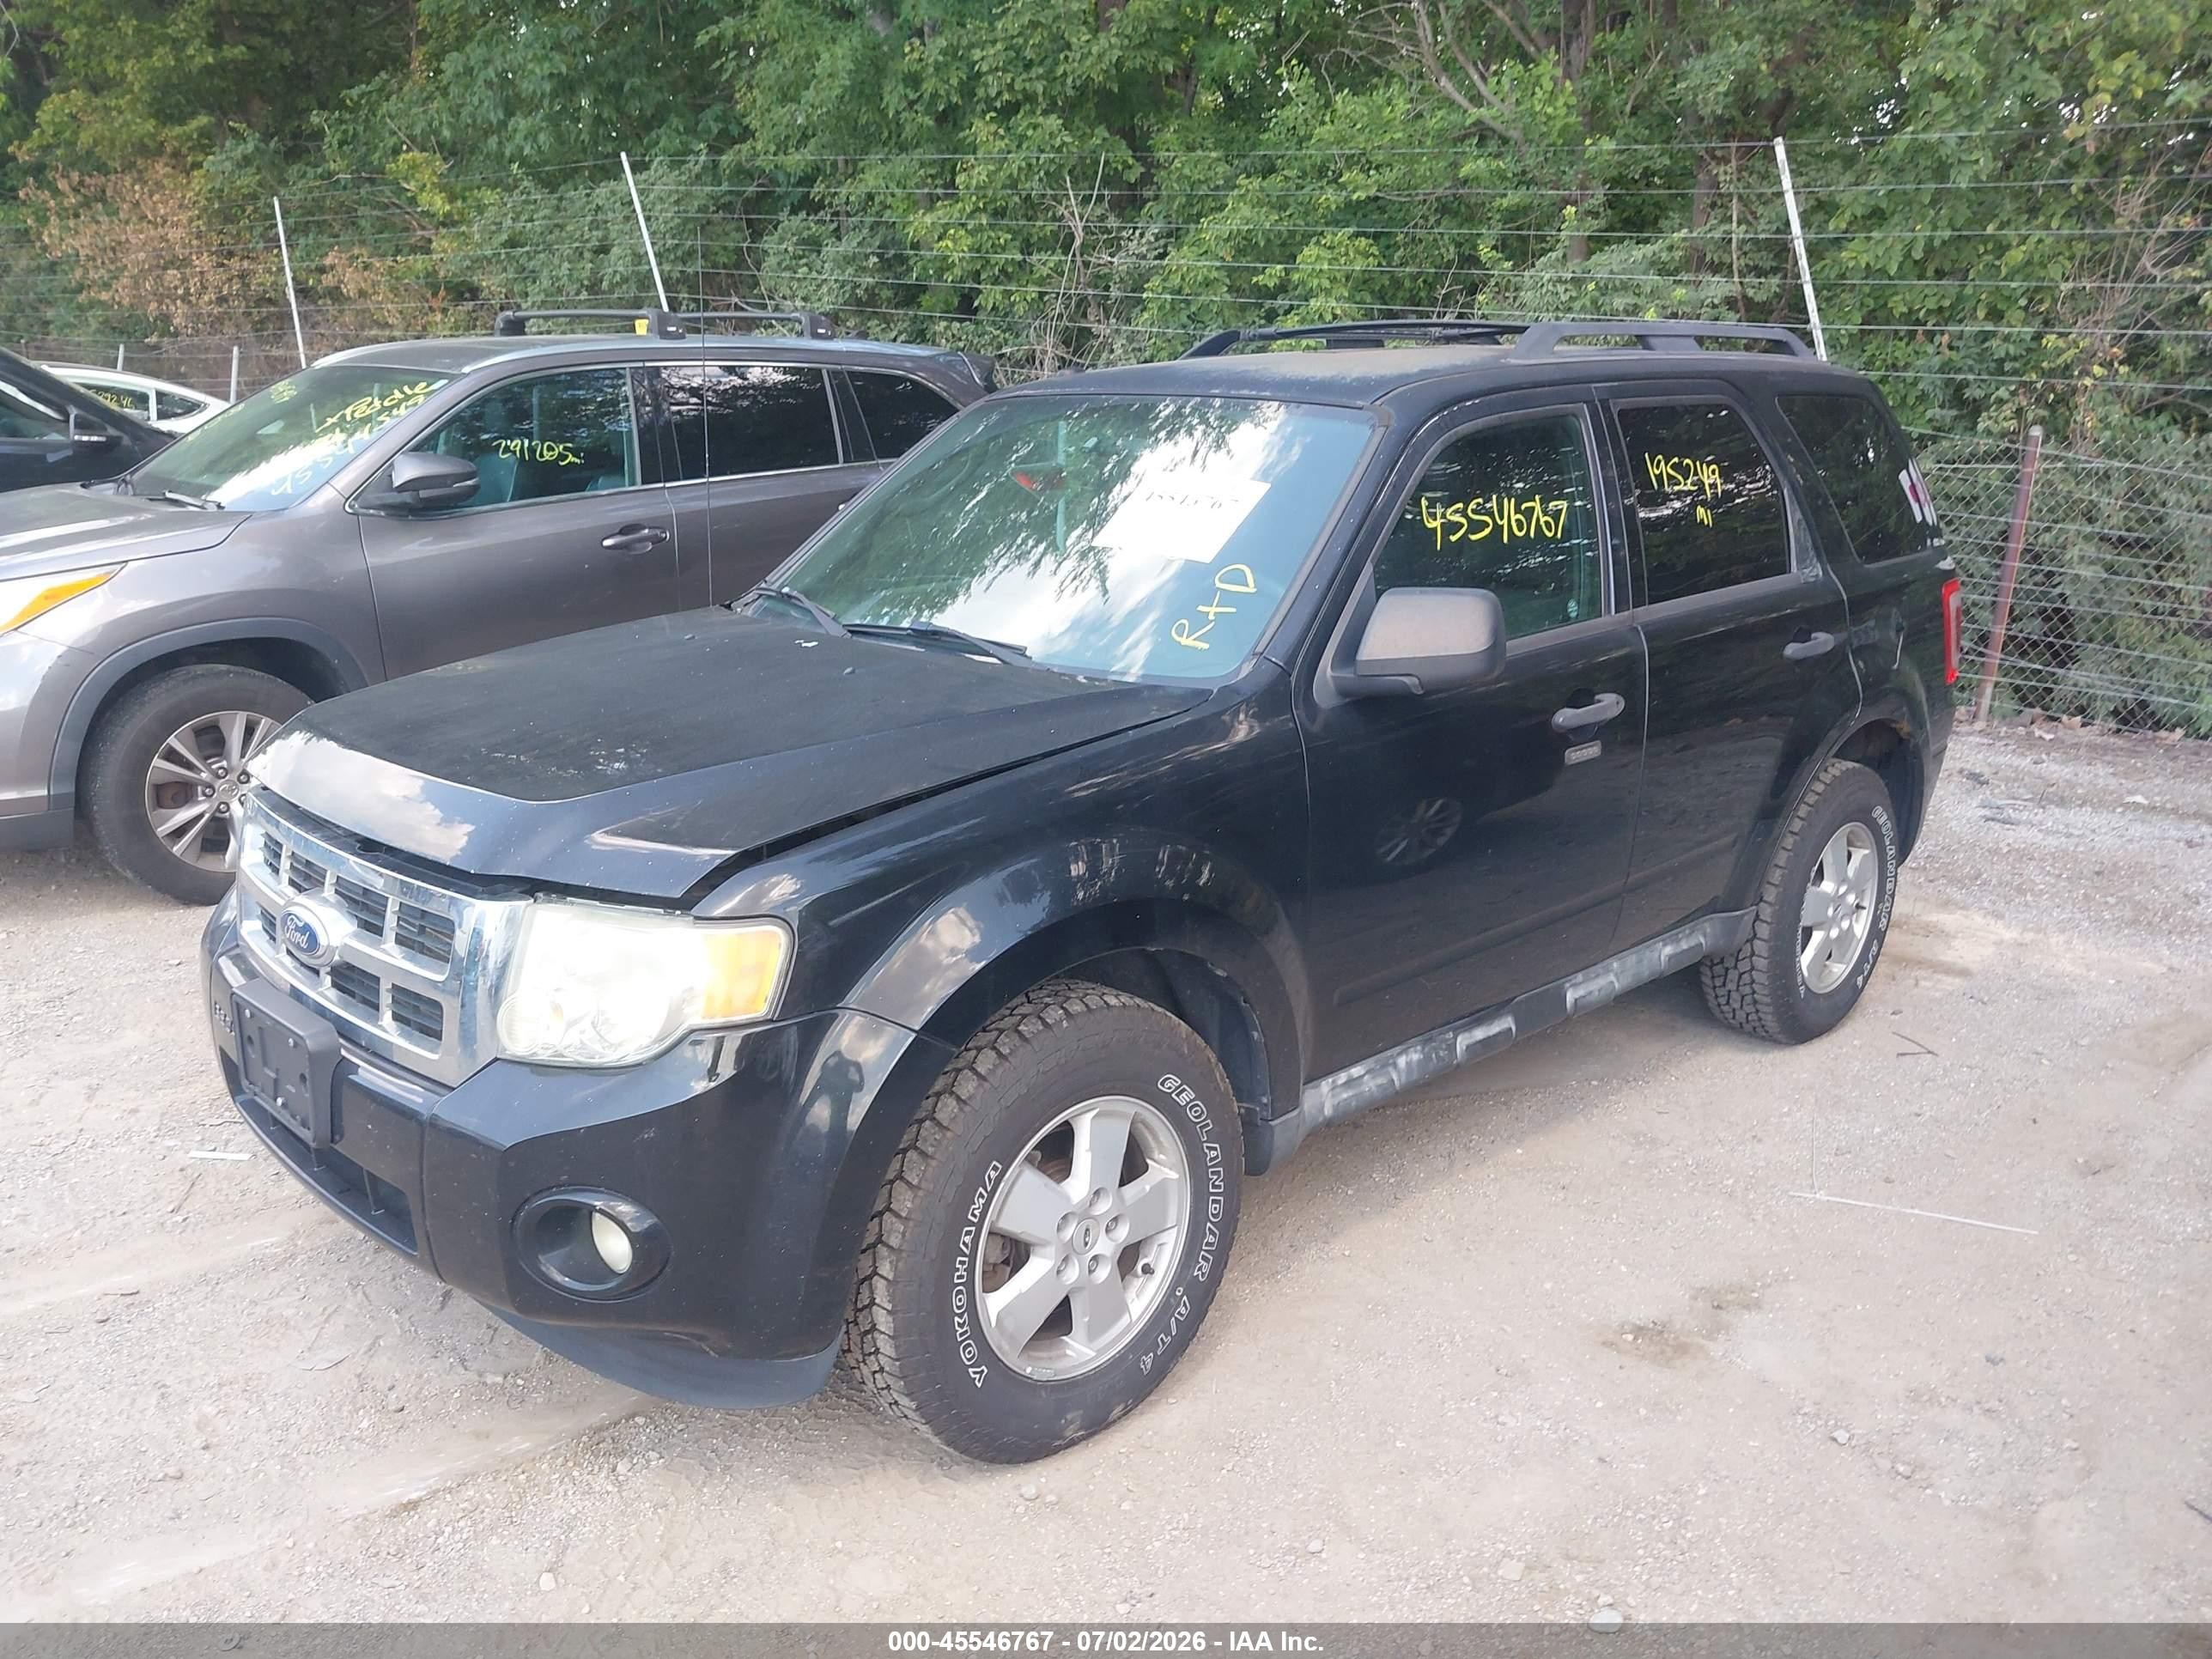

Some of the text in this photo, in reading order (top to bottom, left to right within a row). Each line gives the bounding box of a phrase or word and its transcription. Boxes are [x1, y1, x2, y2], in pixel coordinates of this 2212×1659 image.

[1644, 452, 1722, 501] 195249
[1421, 495, 1568, 550] 45546767
[285, 915, 310, 949] Ford
[1158, 1073, 1224, 1283] GEOLANDAR
[952, 1160, 1003, 1389] YOKOHAMA
